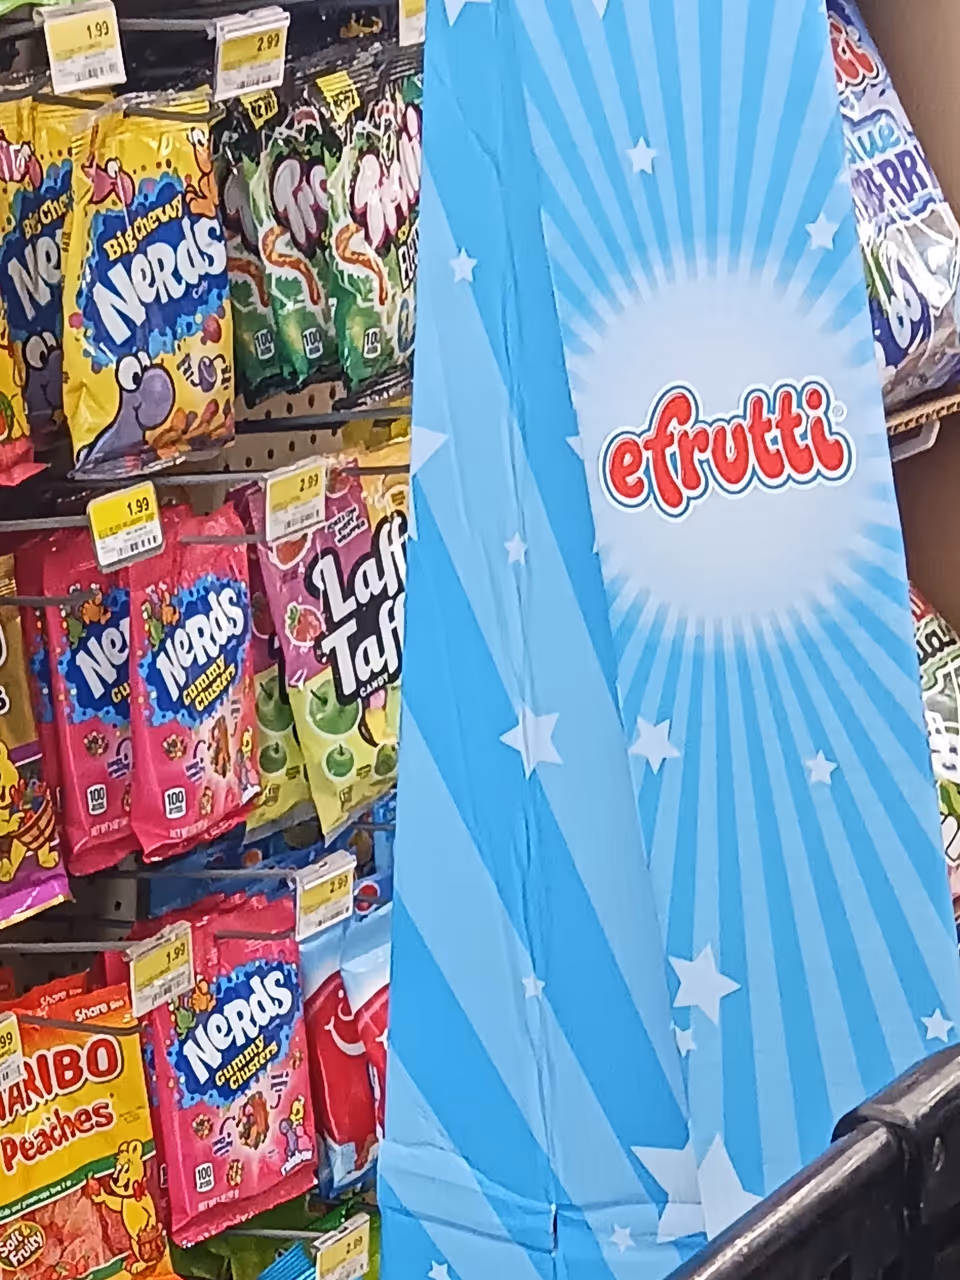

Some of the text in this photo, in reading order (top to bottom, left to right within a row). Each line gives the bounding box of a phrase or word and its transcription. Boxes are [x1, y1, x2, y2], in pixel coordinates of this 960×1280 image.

[103, 195, 184, 263] Big Chewy
[608, 386, 845, 509] efrutti
[126, 496, 150, 516] 1.99
[359, 673, 389, 698] CANDY
[88, 786, 105, 804] 100
[166, 791, 184, 806] 100
[165, 942, 186, 964] 1.99
[74, 1003, 108, 1022] Share
[0, 1100, 115, 1176] Peaches
[196, 1164, 213, 1181] 100
[8, 1232, 44, 1267] Fruity
